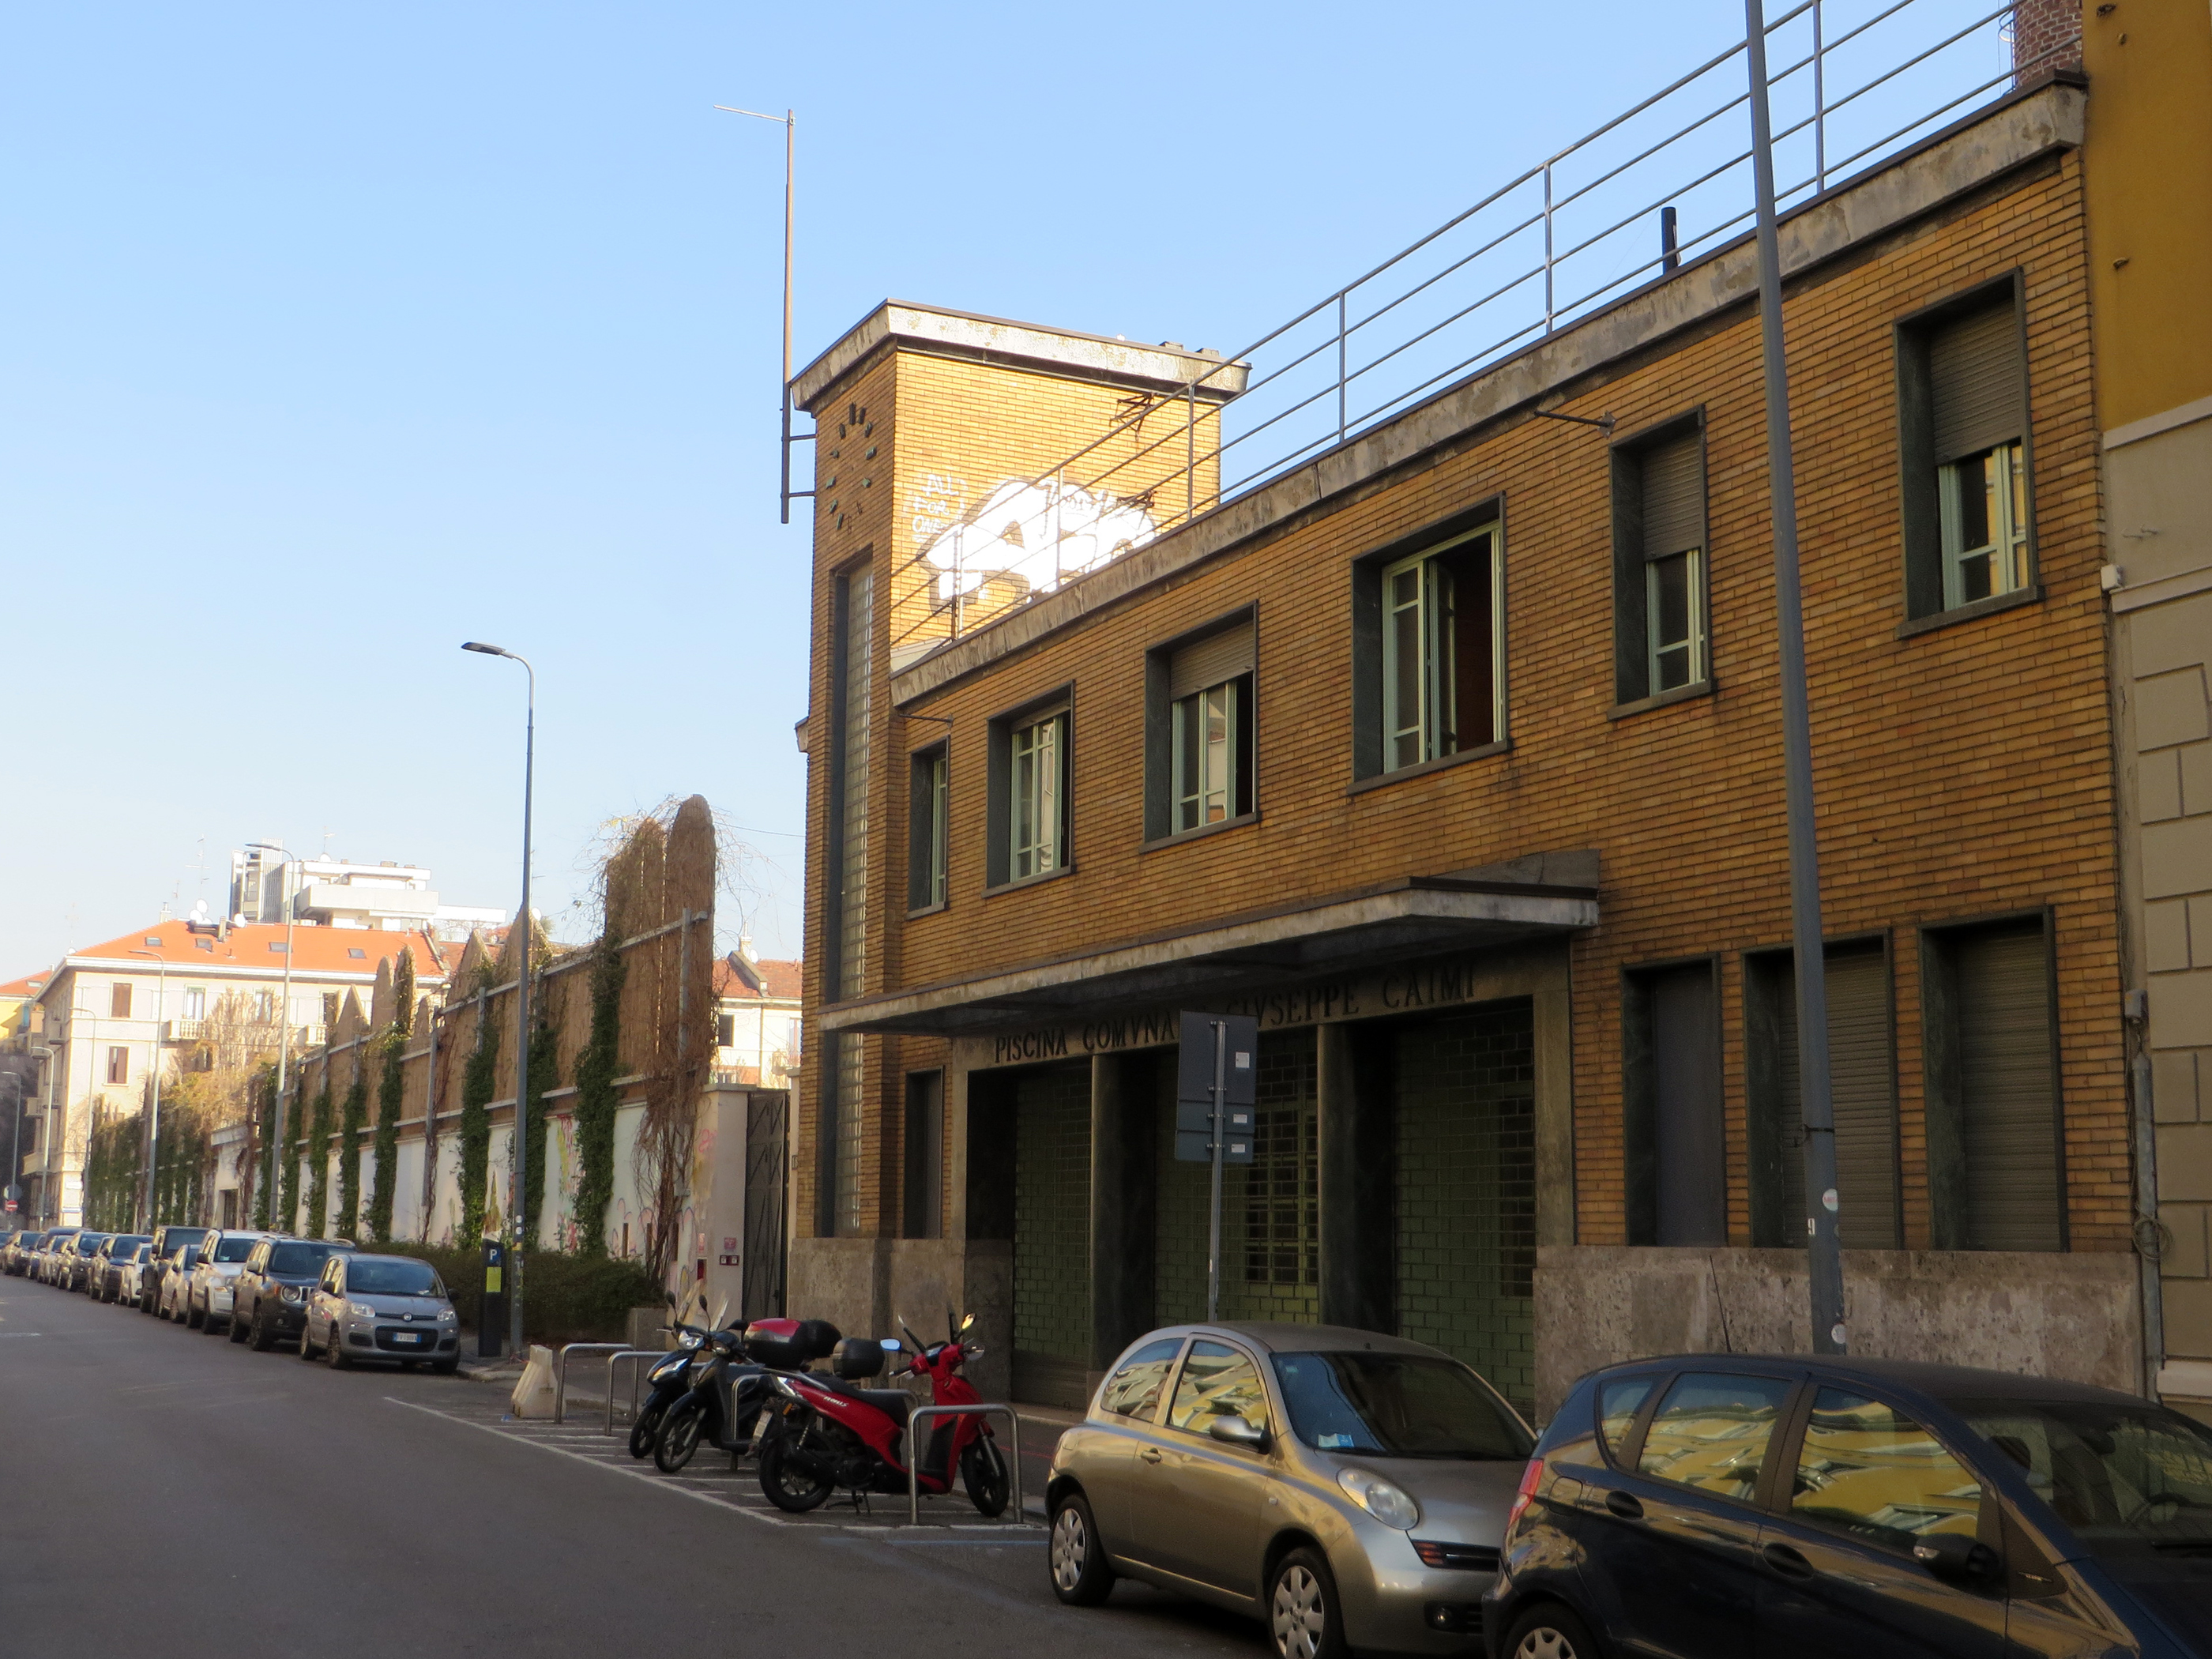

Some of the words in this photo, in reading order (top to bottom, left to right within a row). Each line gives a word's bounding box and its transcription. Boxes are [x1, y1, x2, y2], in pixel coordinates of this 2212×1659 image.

[921, 473, 959, 497] ALL
[912, 497, 950, 515] FOR
[994, 1026, 1068, 1063] PISCINA
[1082, 1010, 1176, 1052] COMVNA
[1382, 965, 1476, 1009] CAIMI
[490, 1249, 498, 1260] P
